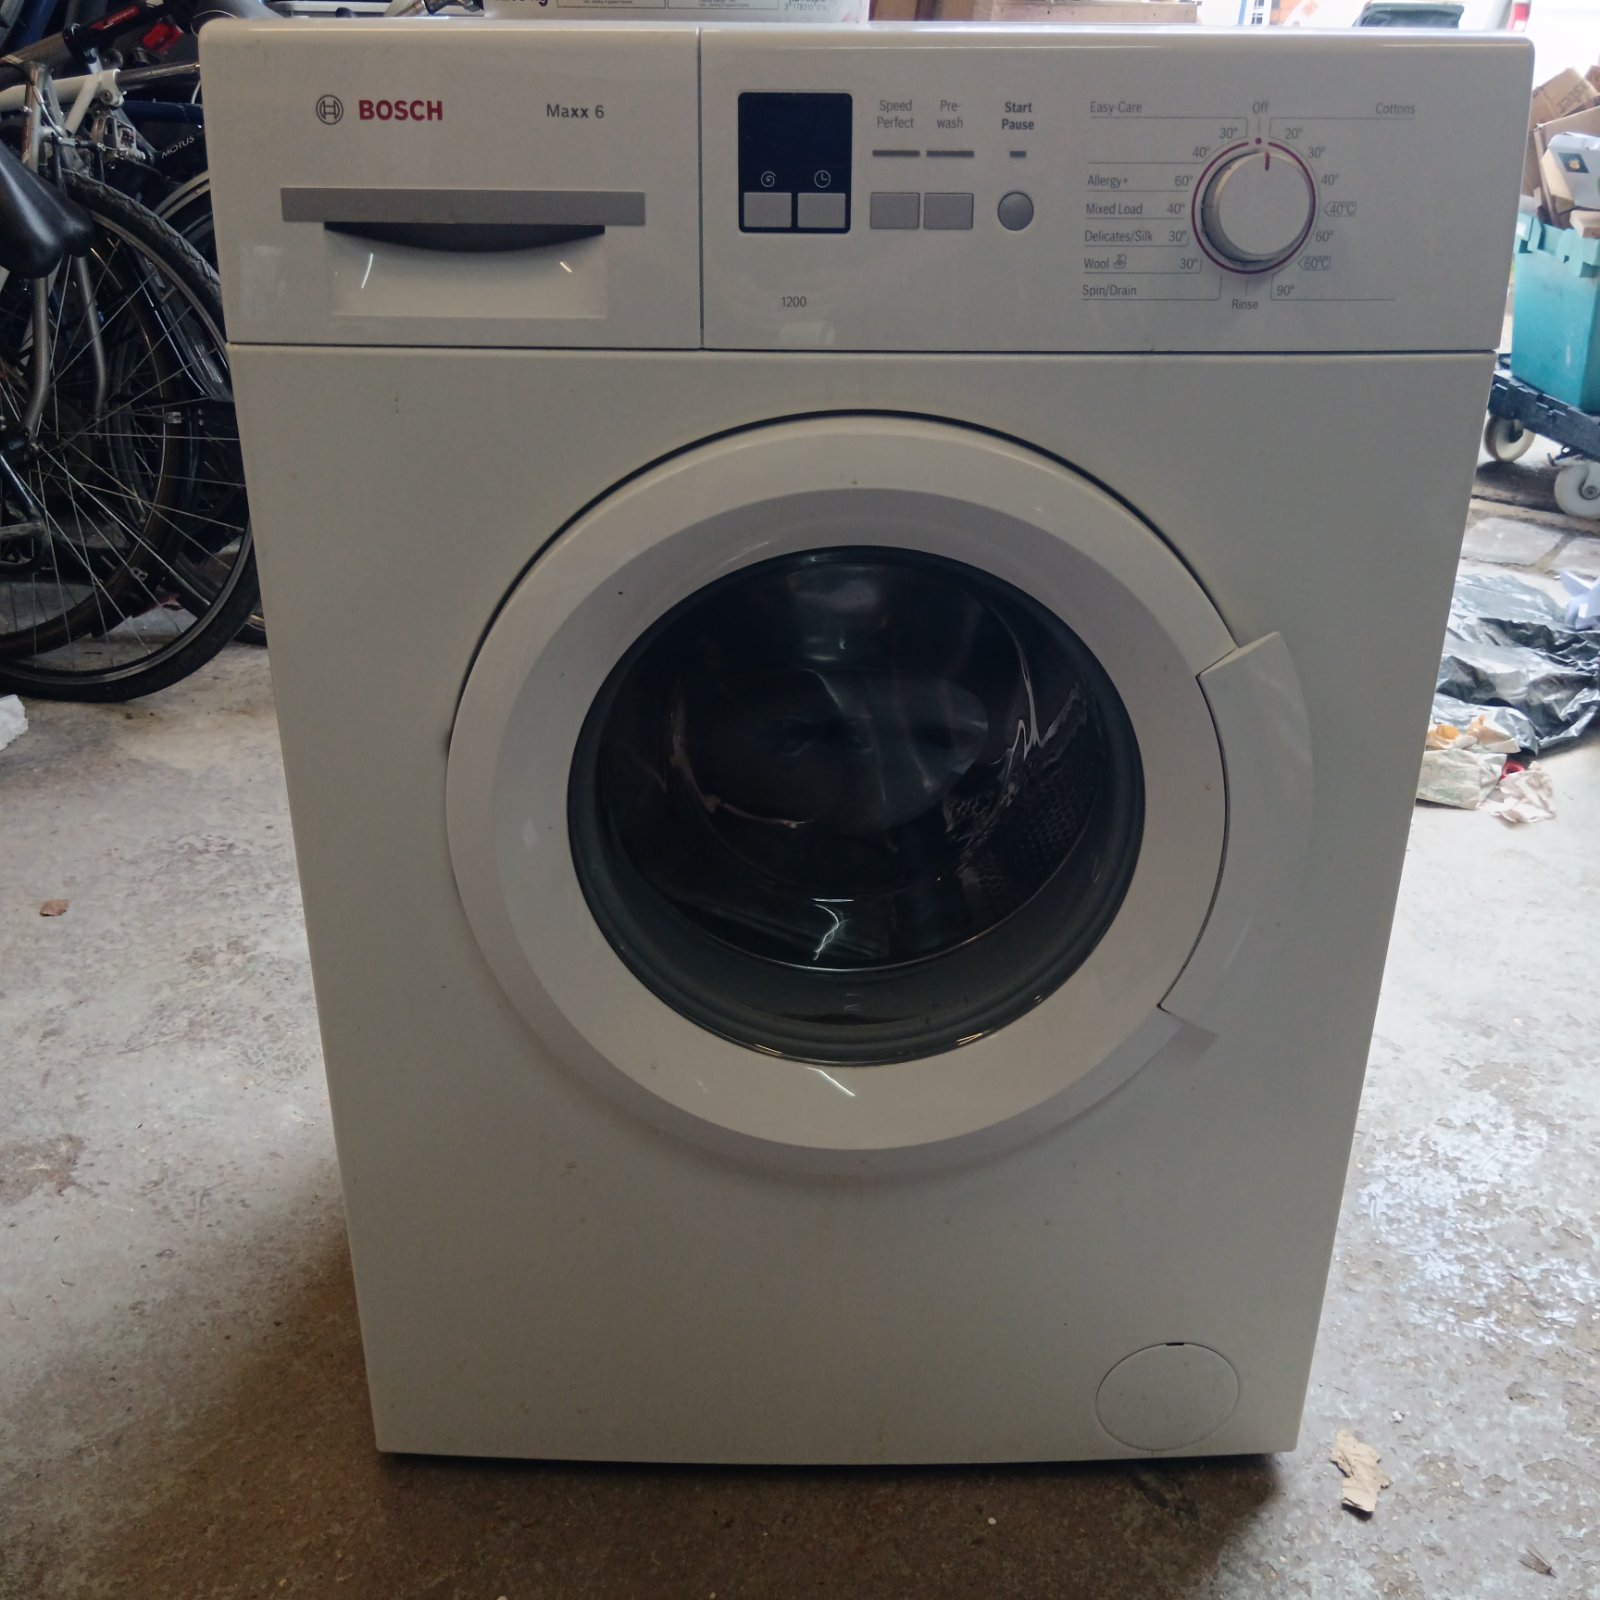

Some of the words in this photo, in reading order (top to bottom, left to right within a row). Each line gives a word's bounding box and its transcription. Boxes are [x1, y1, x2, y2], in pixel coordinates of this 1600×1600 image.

[358, 99, 444, 121] BOSCH
[545, 103, 590, 119] Maxx
[594, 105, 605, 119] 6
[879, 99, 913, 113] Speed
[939, 99, 962, 112] Pre-
[1004, 101, 1033, 114] Start
[1252, 101, 1269, 115] Off
[1375, 102, 1416, 115] Cottons
[876, 116, 915, 129] Perfect
[936, 117, 964, 129] wash
[1001, 117, 1035, 131] Pause
[1219, 127, 1238, 140] 30°
[1284, 127, 1304, 141] 20°
[161, 135, 196, 159] MOTUS
[1192, 145, 1211, 159] 40°
[1307, 146, 1326, 159] 30°
[1087, 174, 1129, 189] Allergy+
[1174, 175, 1194, 187] 60°
[1320, 172, 1340, 186] 40°
[1085, 203, 1116, 215] Mixed
[1118, 203, 1143, 215] Load
[1166, 203, 1186, 215] 40°
[1084, 230, 1153, 243] Delicates/Silk
[1168, 230, 1187, 242] 30°
[1315, 230, 1335, 242] 60°
[1083, 258, 1110, 270] Wool
[1179, 257, 1199, 270] 30°
[1082, 284, 1137, 297] Spin/Drain
[1276, 284, 1296, 297] 90°
[781, 295, 808, 308] 1200
[1231, 298, 1259, 310] Rinse
